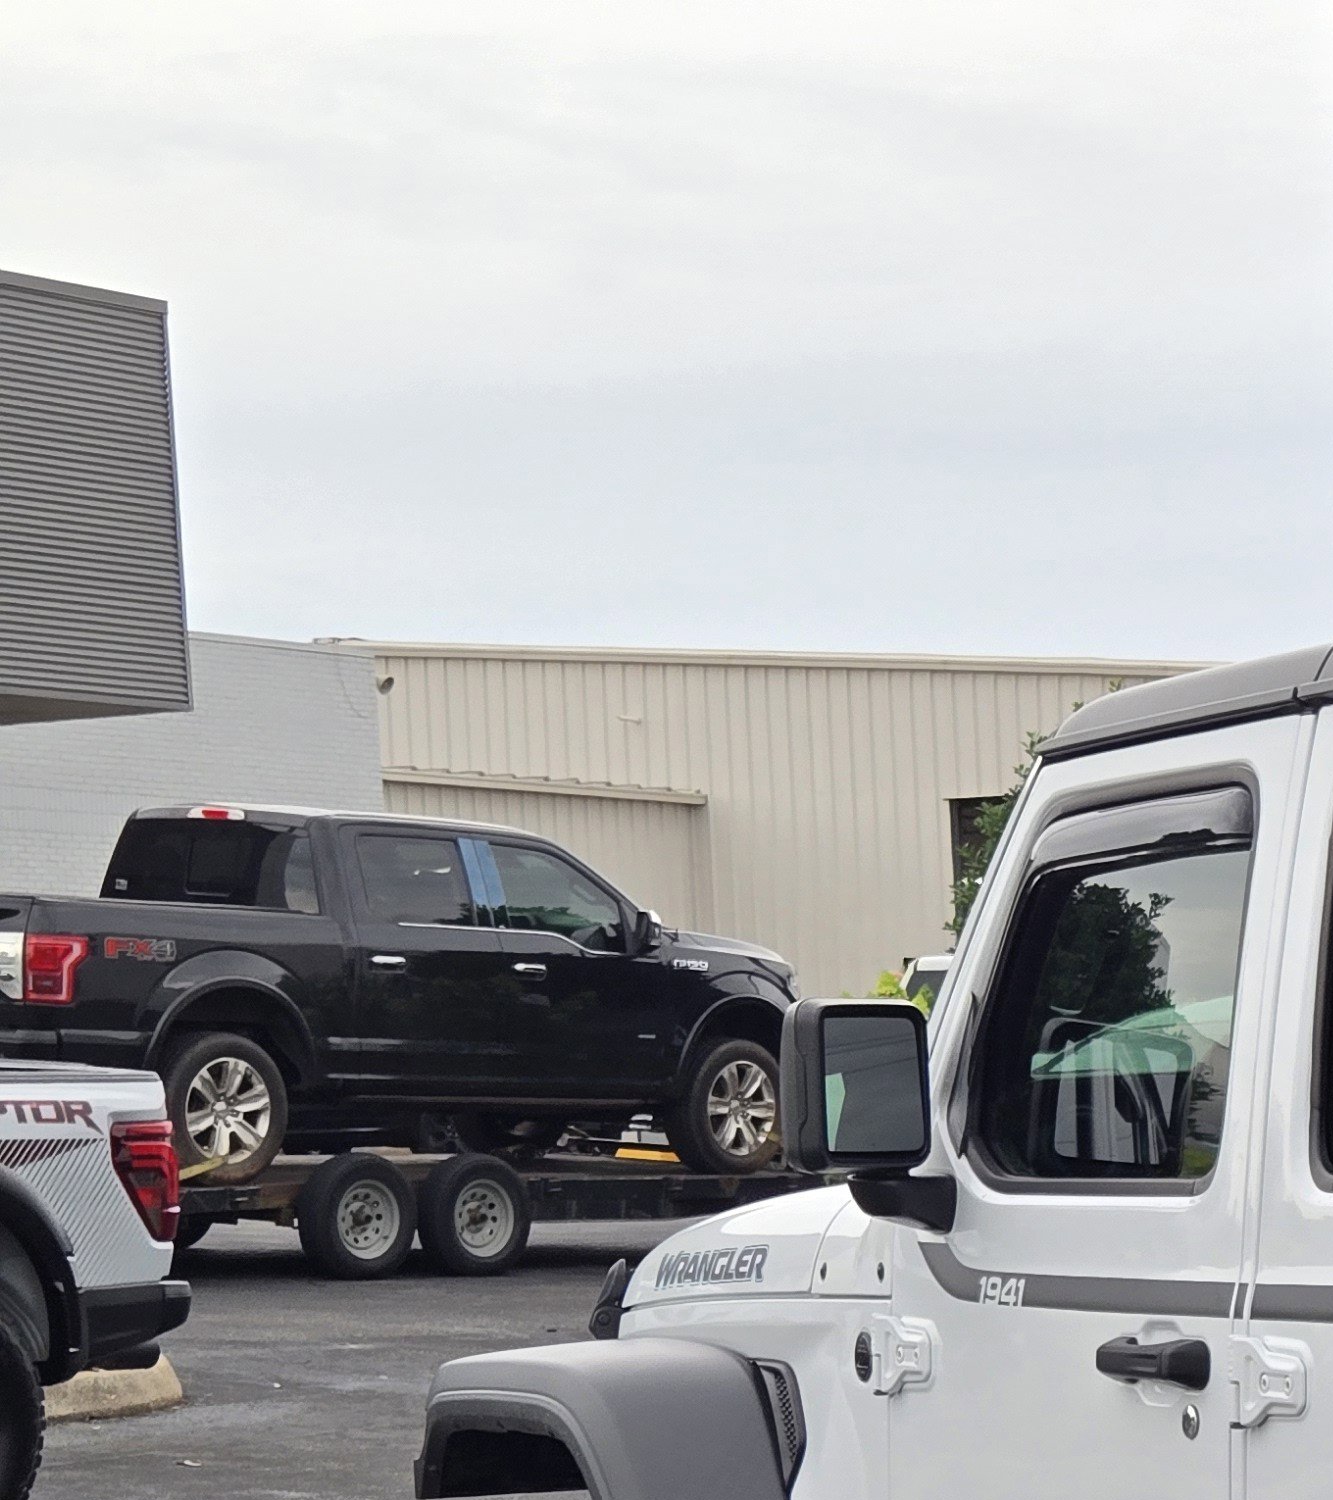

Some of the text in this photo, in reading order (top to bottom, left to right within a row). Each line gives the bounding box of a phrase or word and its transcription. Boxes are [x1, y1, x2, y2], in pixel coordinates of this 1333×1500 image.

[104, 936, 176, 961] FX4
[0, 1101, 103, 1135] TOR
[654, 1244, 769, 1291] WRANGLER
[979, 1276, 1026, 1308] 1941
